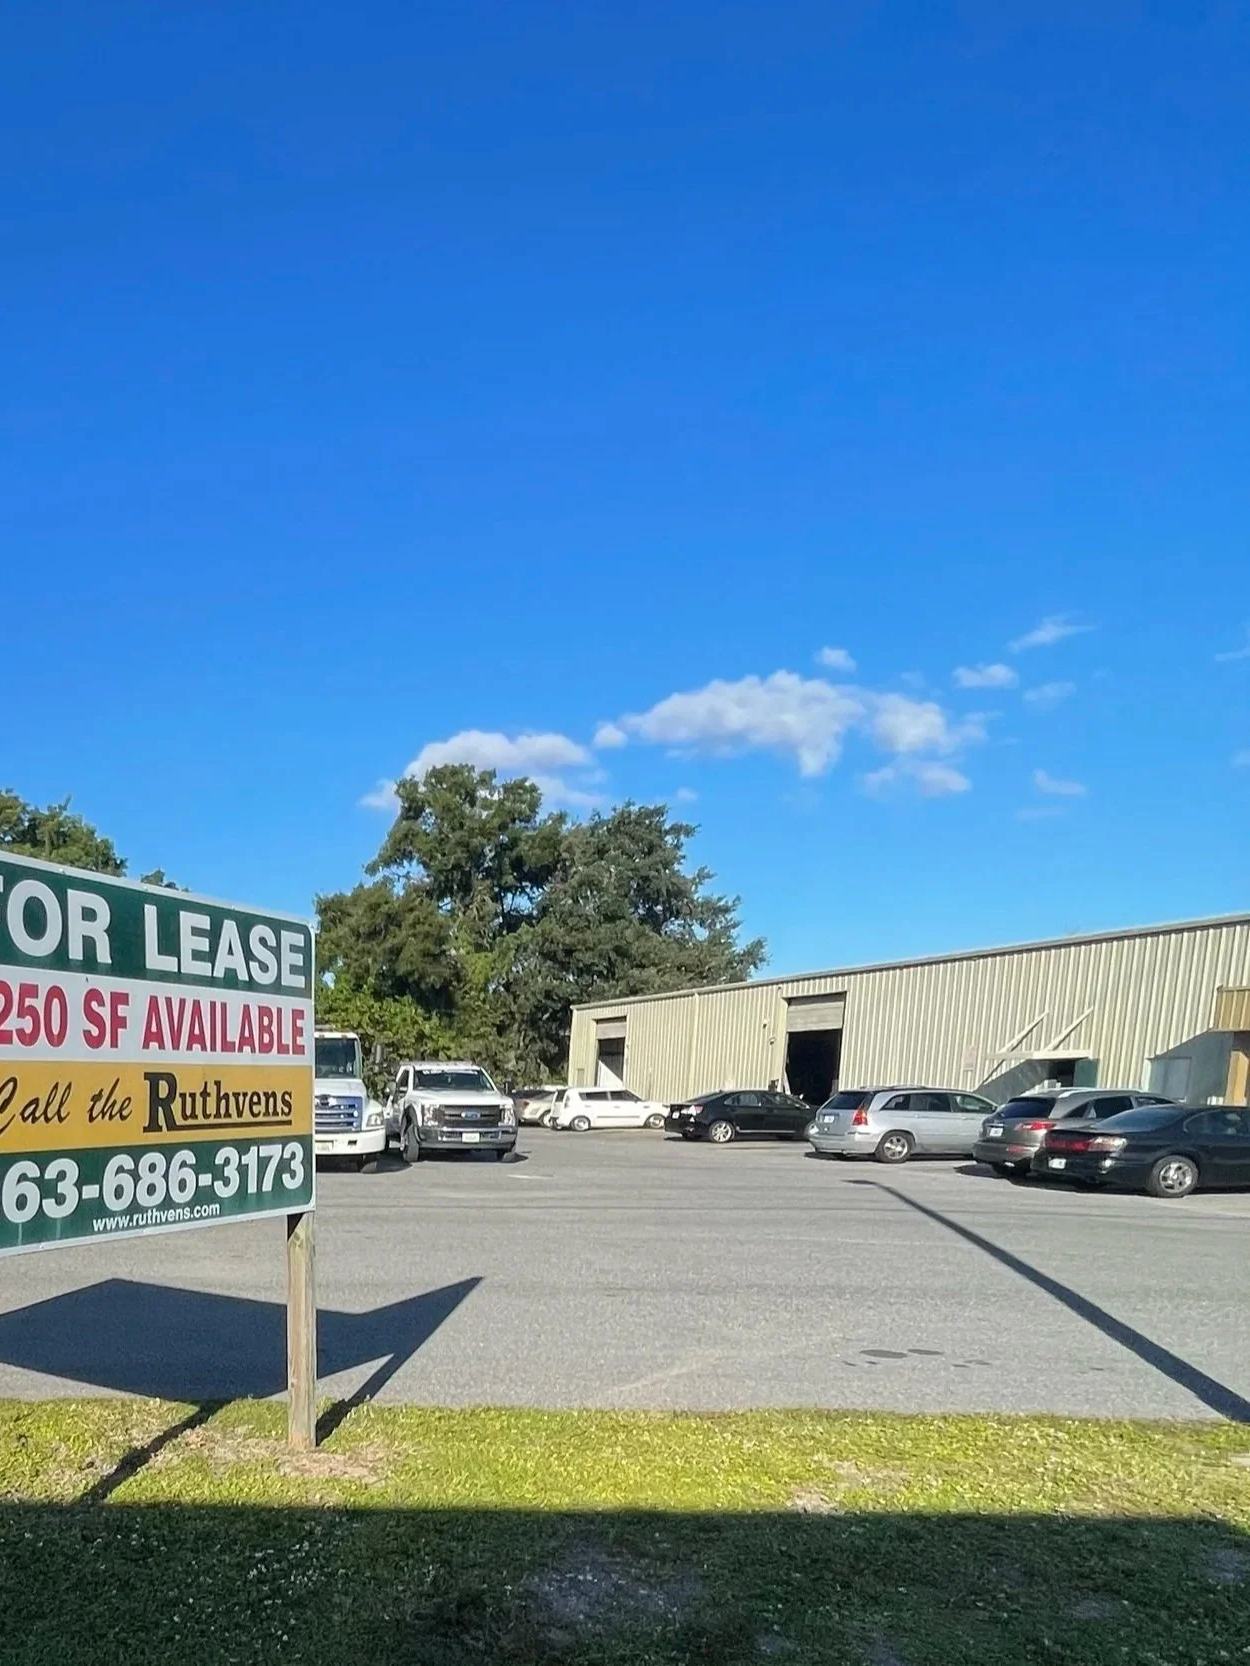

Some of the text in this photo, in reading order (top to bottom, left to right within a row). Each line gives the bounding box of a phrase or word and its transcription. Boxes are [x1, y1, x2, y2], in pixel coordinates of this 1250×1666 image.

[143, 904, 306, 988] LEASE
[82, 988, 130, 1049] SF
[141, 994, 306, 1056] AVAILABLE
[86, 1078, 133, 1123] the
[142, 1071, 293, 1133] Ruthvens
[92, 1202, 220, 1232] www.ruthvens.com
